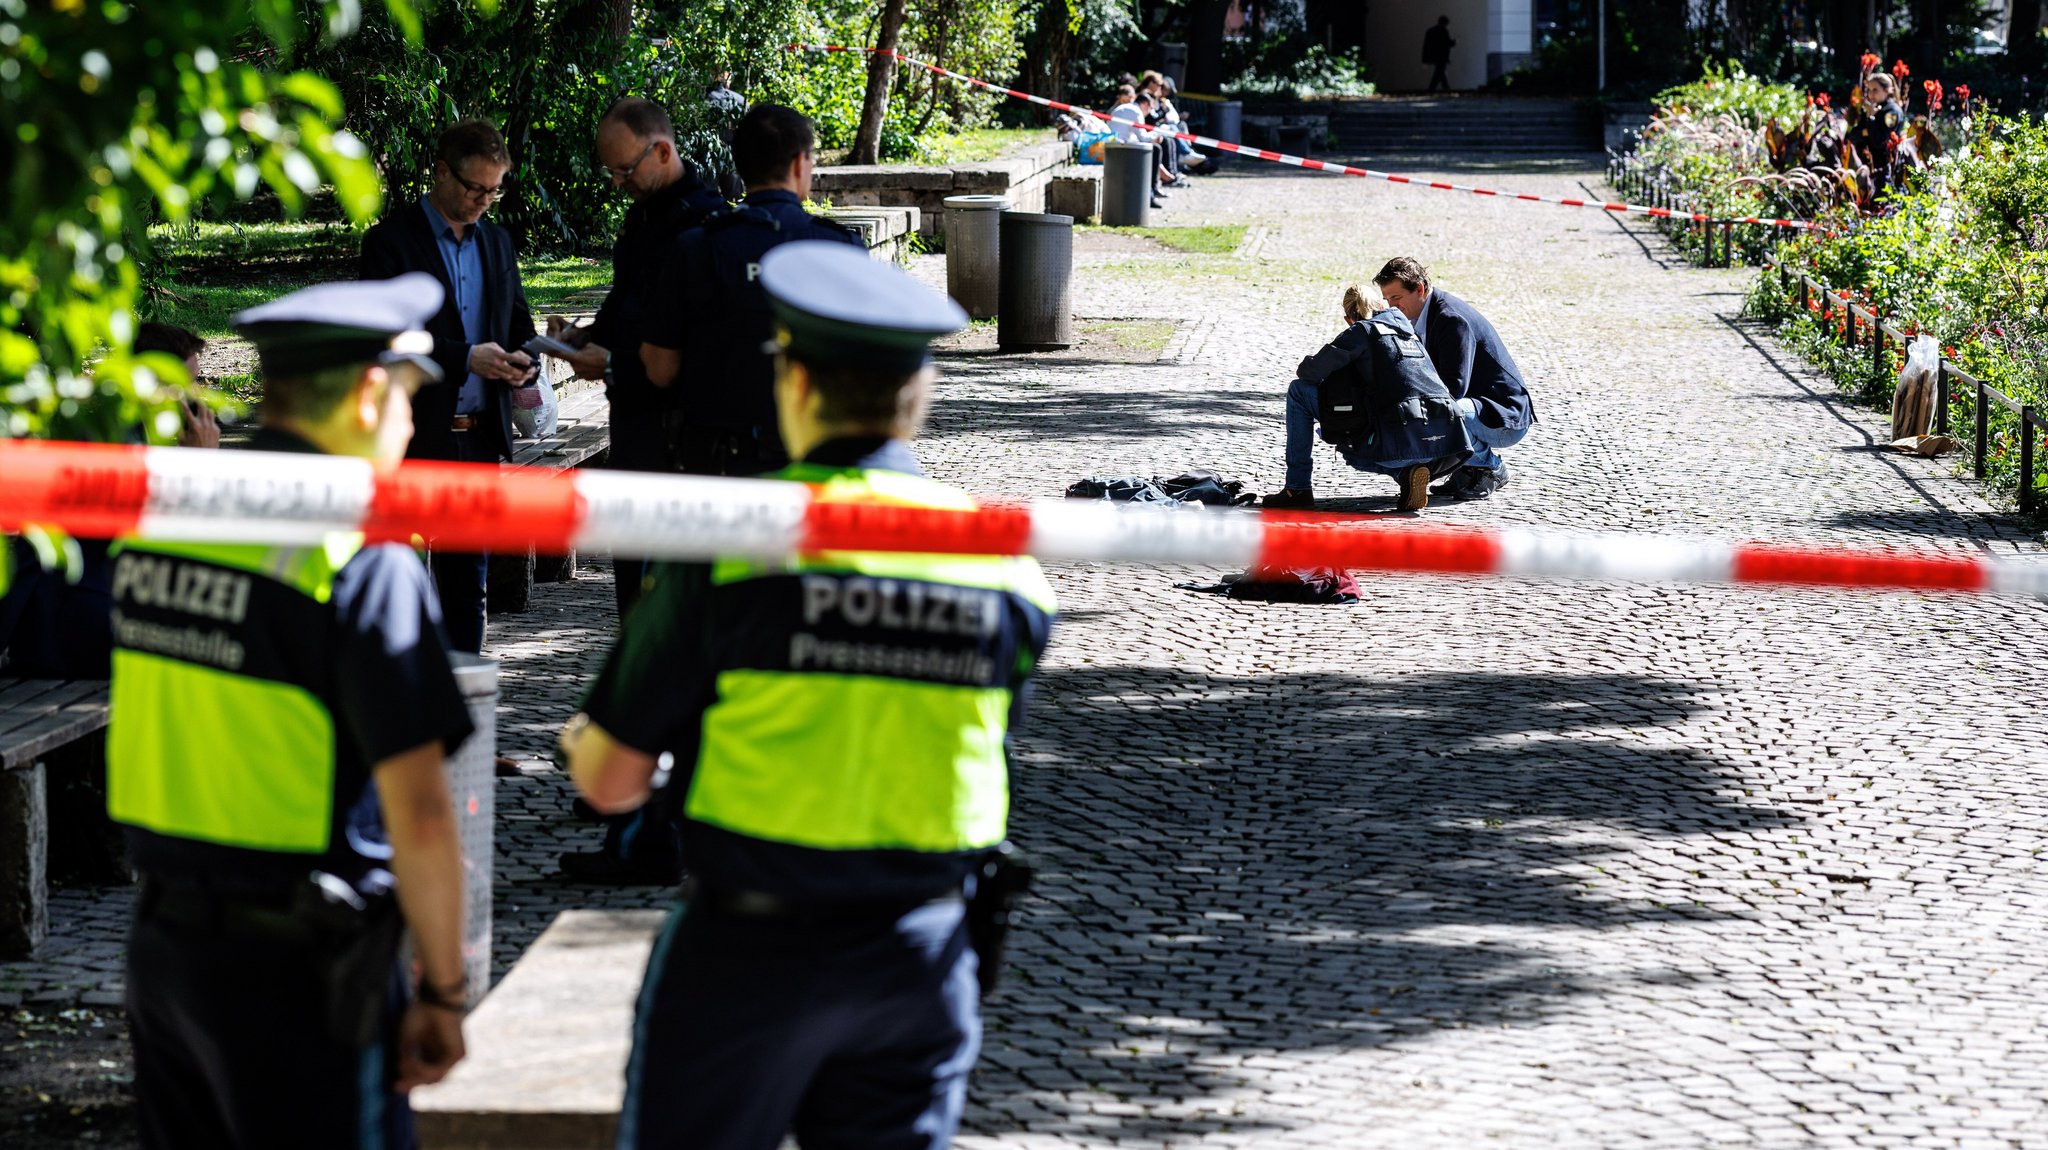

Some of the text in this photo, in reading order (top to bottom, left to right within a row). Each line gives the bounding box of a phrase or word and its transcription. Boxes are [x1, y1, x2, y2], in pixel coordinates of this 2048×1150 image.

[112, 554, 251, 624] POLIZEI
[803, 575, 999, 636] POLIZEI
[791, 632, 996, 684] Pressestelle
